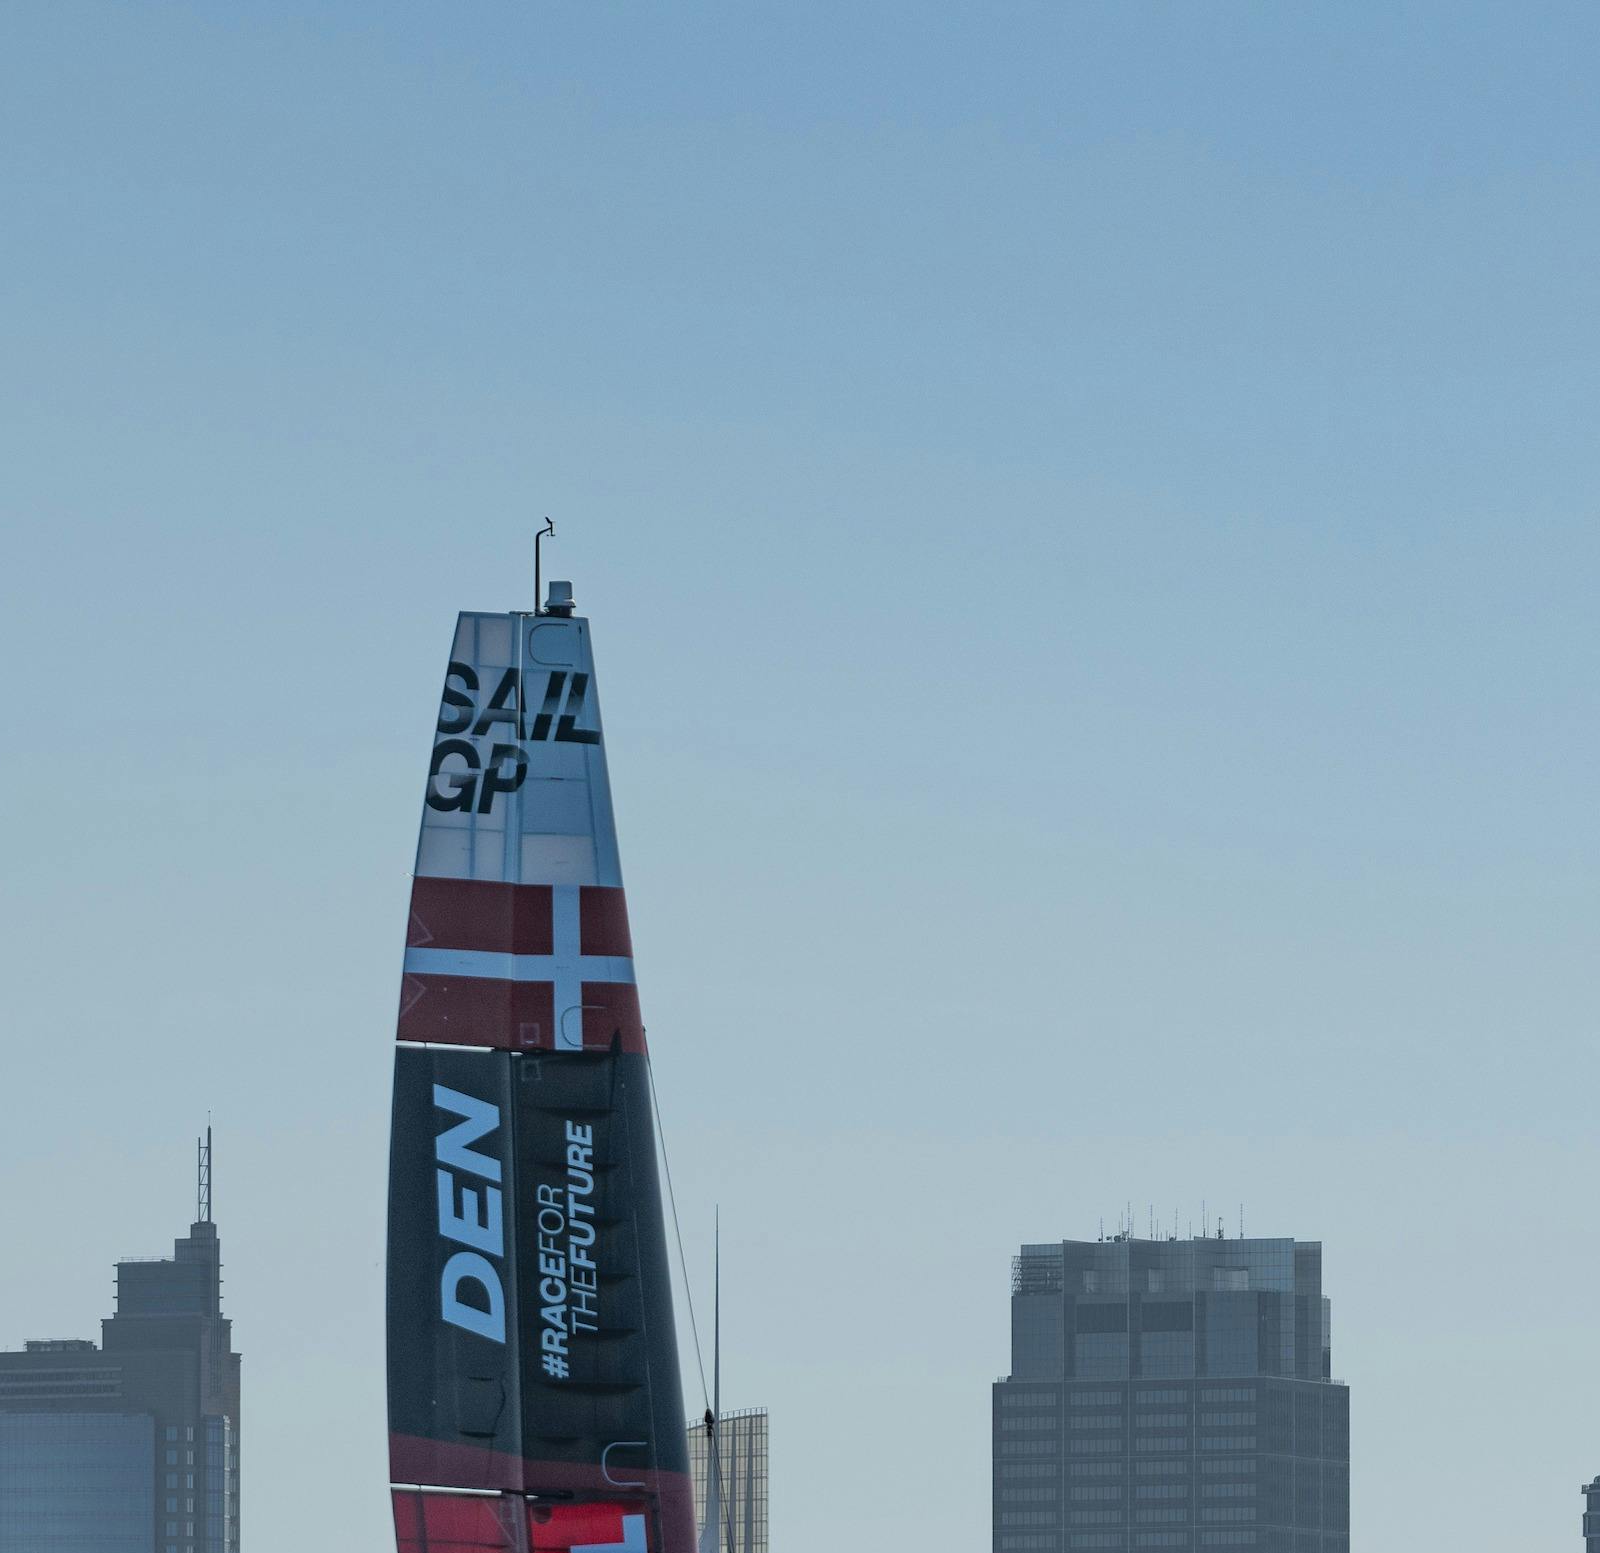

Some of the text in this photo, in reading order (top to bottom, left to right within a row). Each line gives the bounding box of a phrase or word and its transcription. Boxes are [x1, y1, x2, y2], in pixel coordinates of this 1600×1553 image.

[437, 661, 600, 745] SAIL
[424, 739, 530, 814] GP
[433, 1083, 506, 1344] DEN
